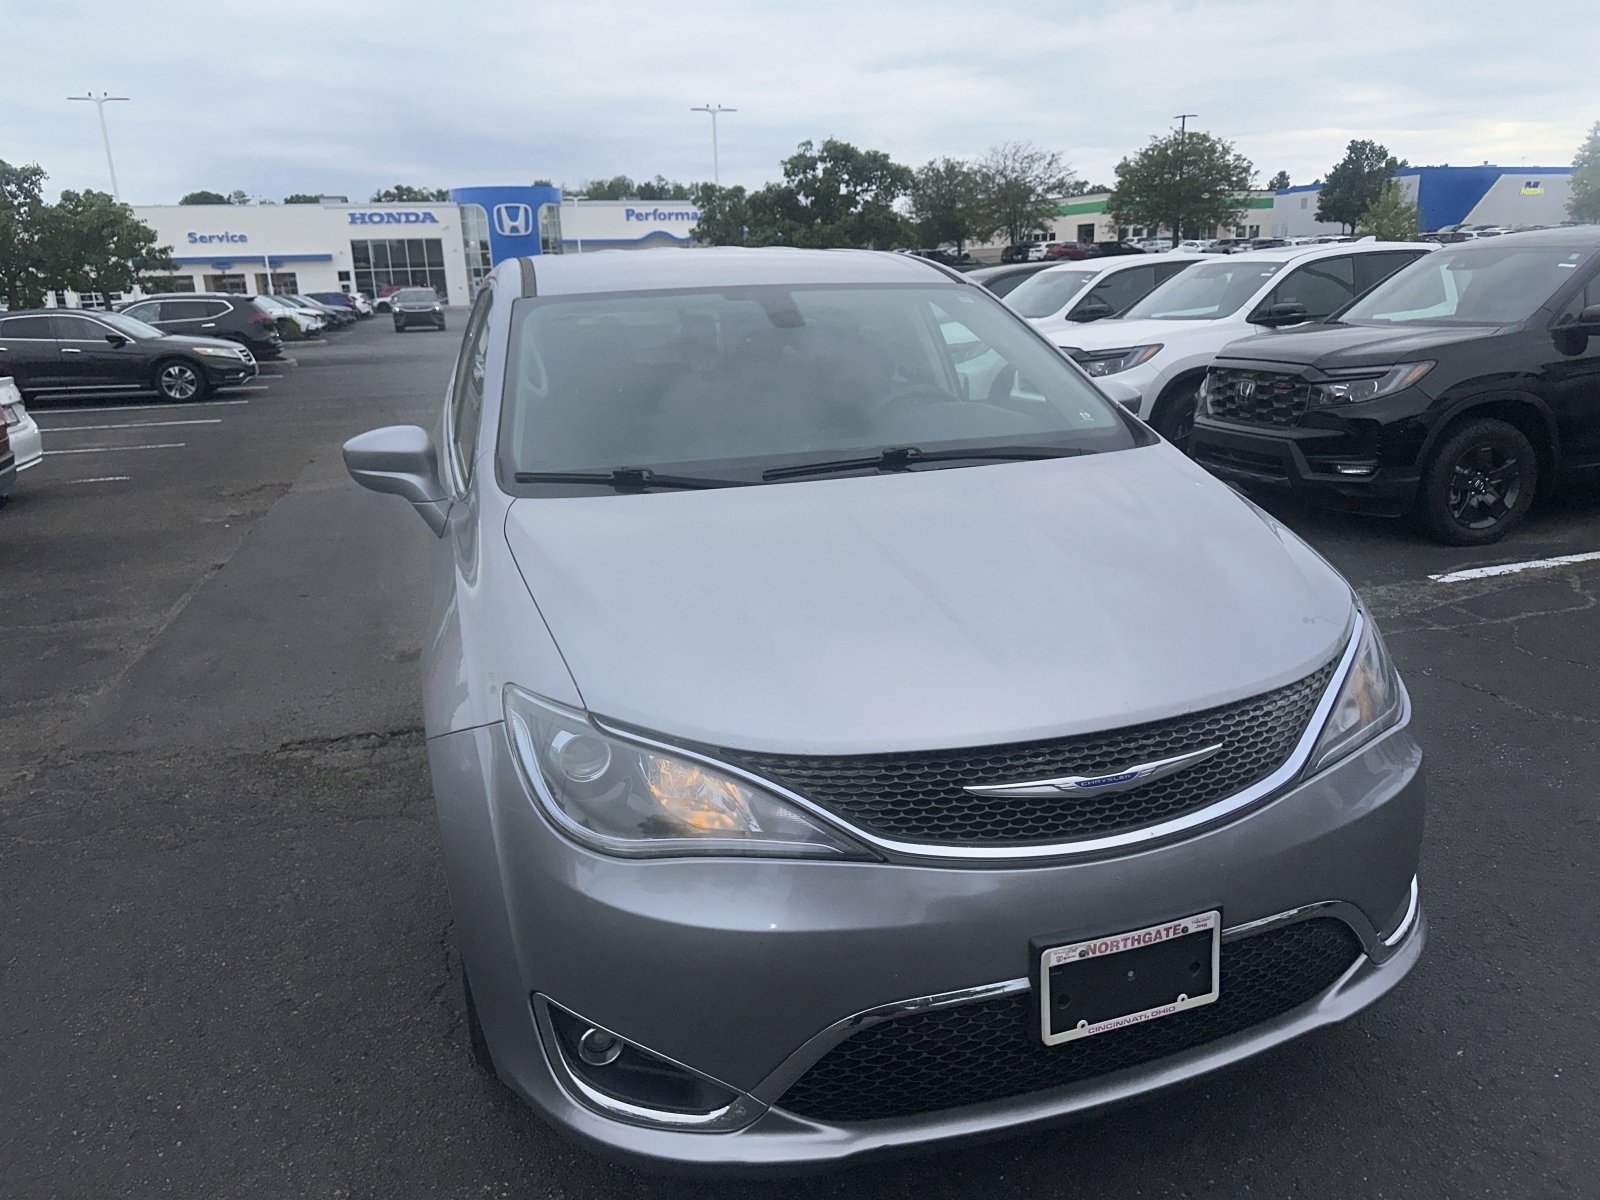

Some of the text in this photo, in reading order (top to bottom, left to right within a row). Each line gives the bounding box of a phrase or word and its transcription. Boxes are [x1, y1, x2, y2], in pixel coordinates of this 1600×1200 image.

[348, 212, 439, 225] HONDA
[187, 231, 248, 244] Service
[1081, 775, 1131, 786] CHRYSLER
[1086, 924, 1182, 956] NORTHGATE
[1151, 1006, 1176, 1017] OHIO
